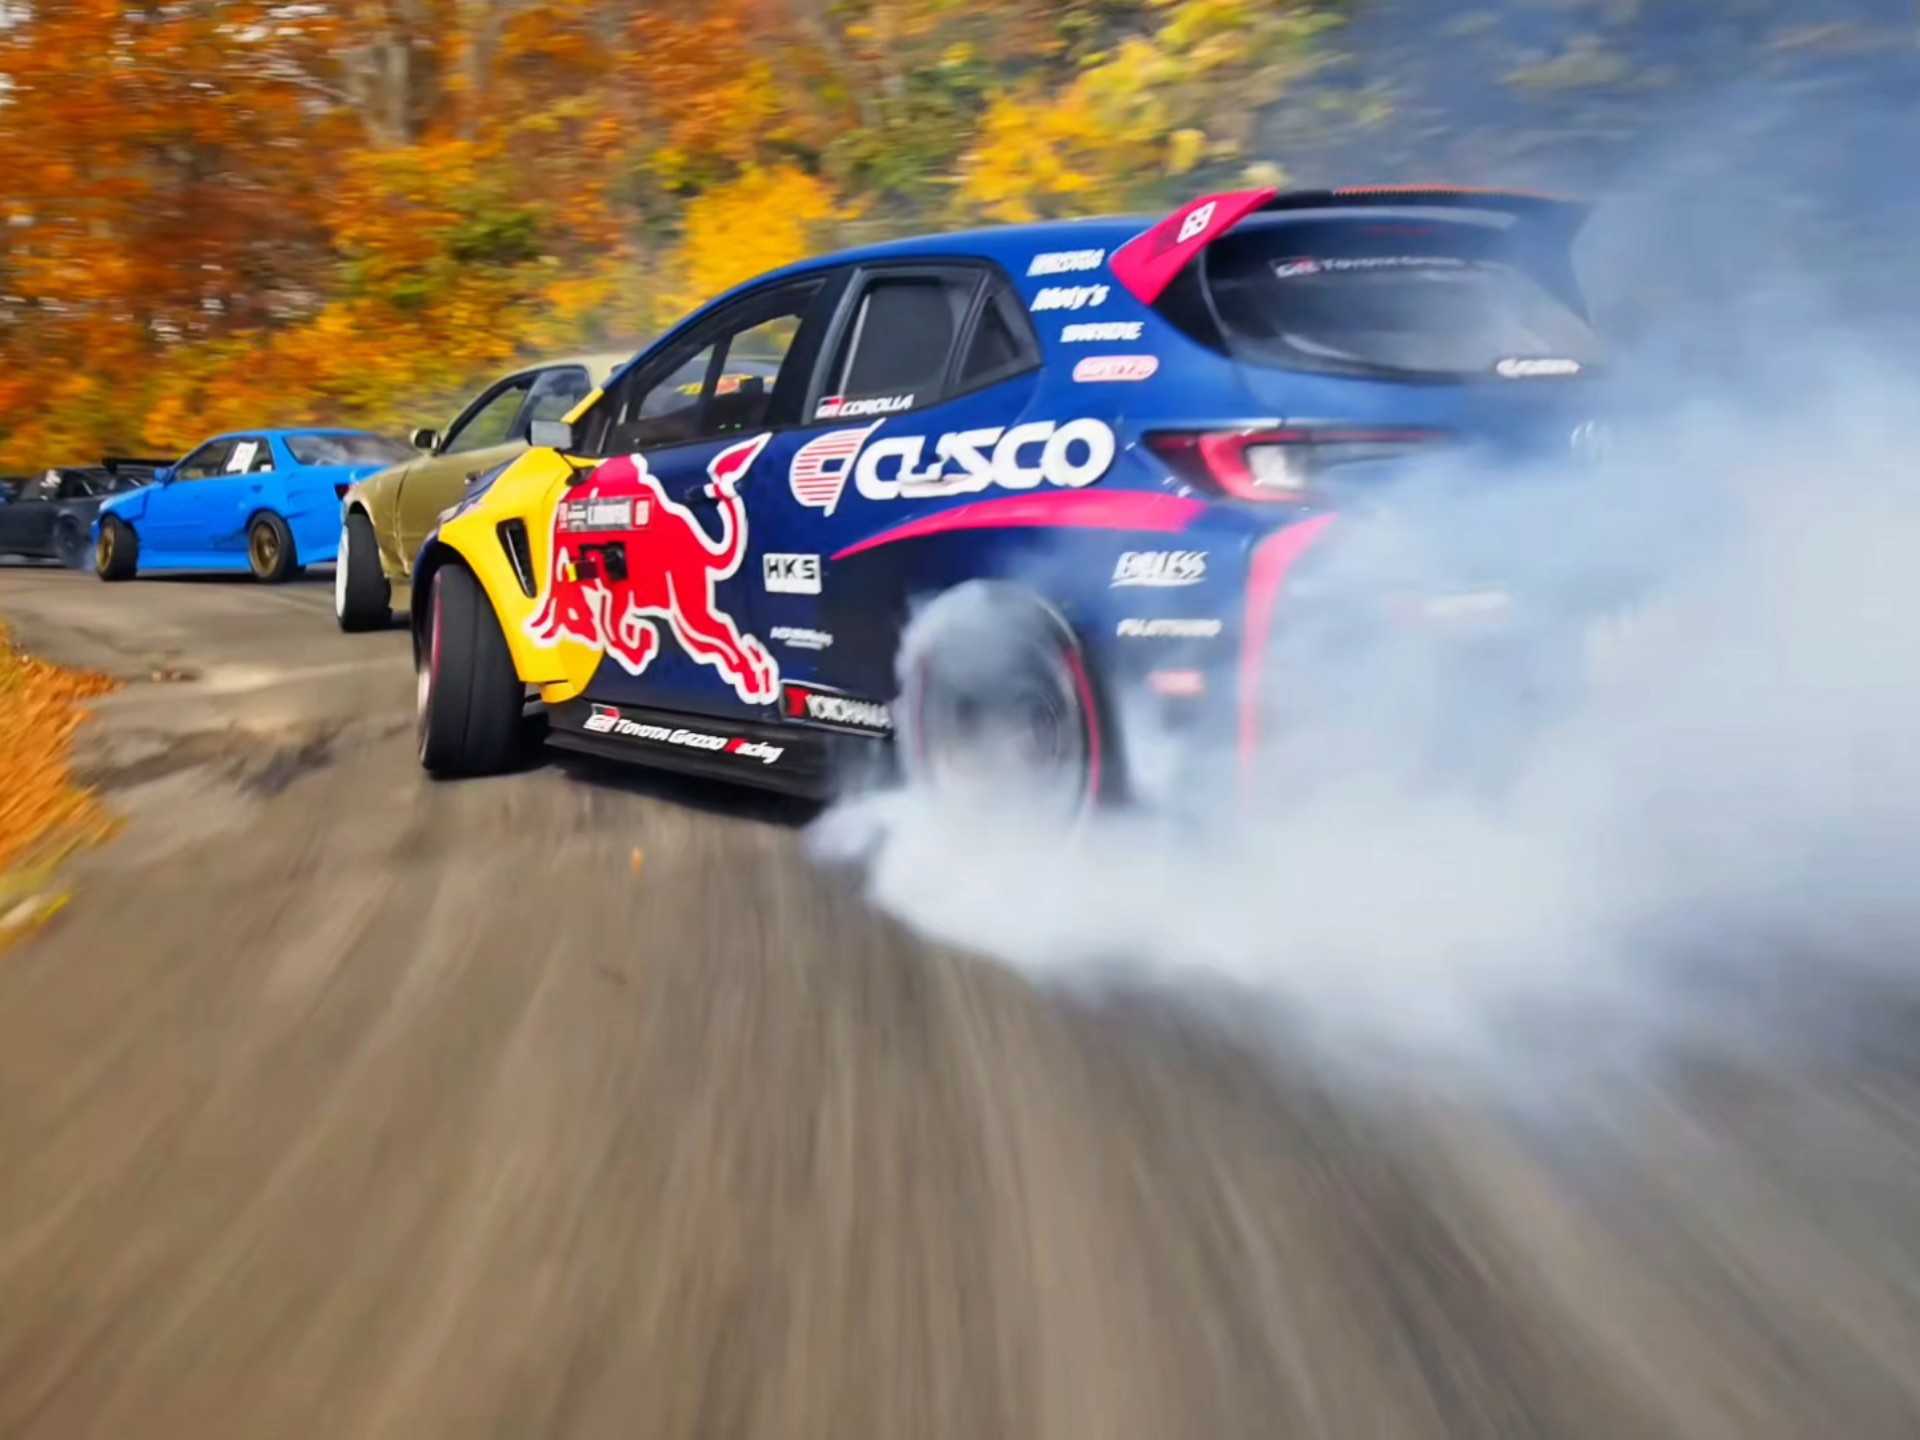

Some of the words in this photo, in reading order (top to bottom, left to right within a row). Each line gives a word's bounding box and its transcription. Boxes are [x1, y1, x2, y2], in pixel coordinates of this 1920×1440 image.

[839, 393, 914, 416] COROLLA
[854, 417, 1116, 501] CUSCO
[766, 558, 816, 580] HKS
